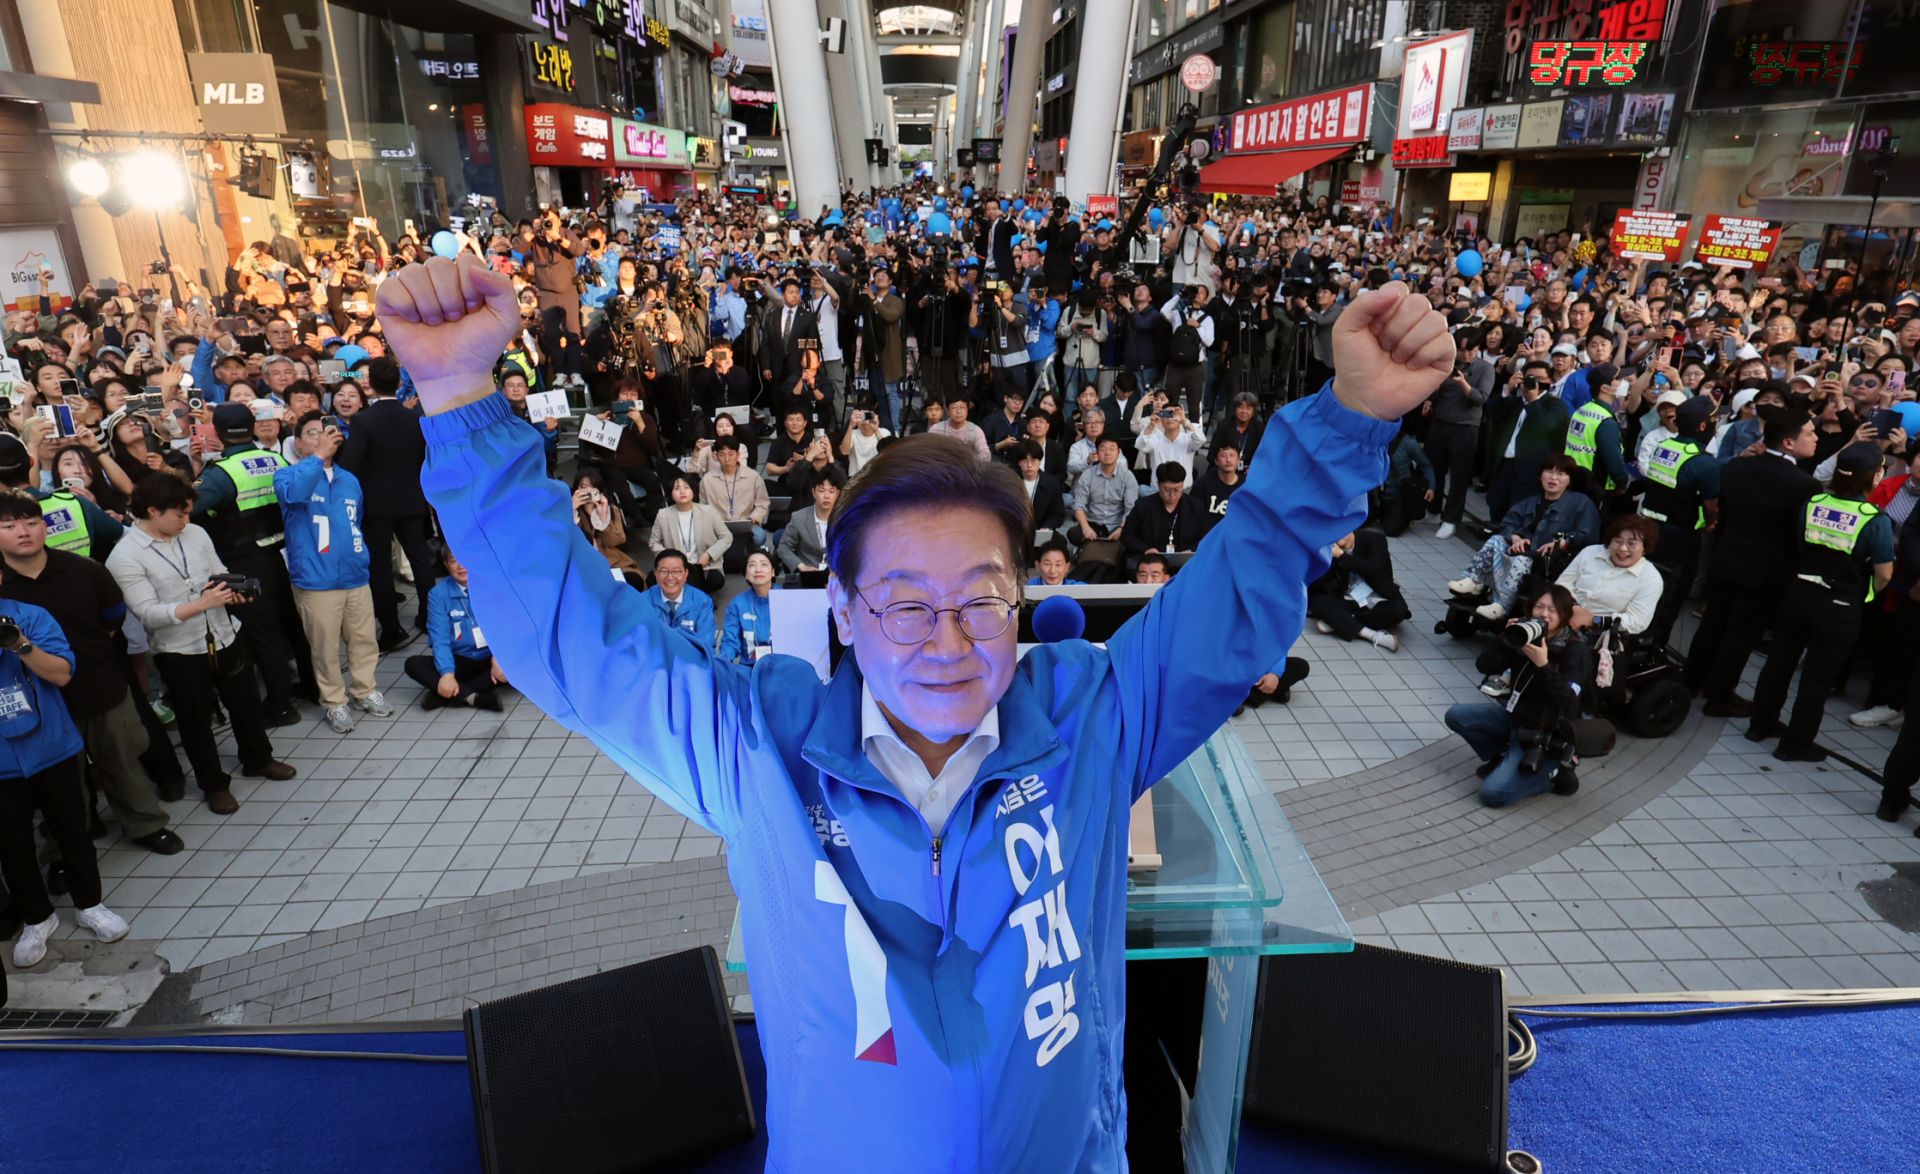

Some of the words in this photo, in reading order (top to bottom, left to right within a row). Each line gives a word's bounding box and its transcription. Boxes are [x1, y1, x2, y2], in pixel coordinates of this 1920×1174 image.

[534, 42, 572, 92] 노래방
[1530, 42, 1647, 86] 당구장
[203, 83, 265, 105] MLB
[533, 115, 555, 126] 보드
[534, 128, 556, 141] 게임
[752, 147, 778, 158] YOUNG
[543, 395, 549, 404] 1
[600, 421, 606, 430] 1
[312, 514, 330, 553] 1
[1813, 518, 1849, 532] POLICE
[1004, 803, 1081, 1067] 이재명
[814, 859, 898, 1066] 1
